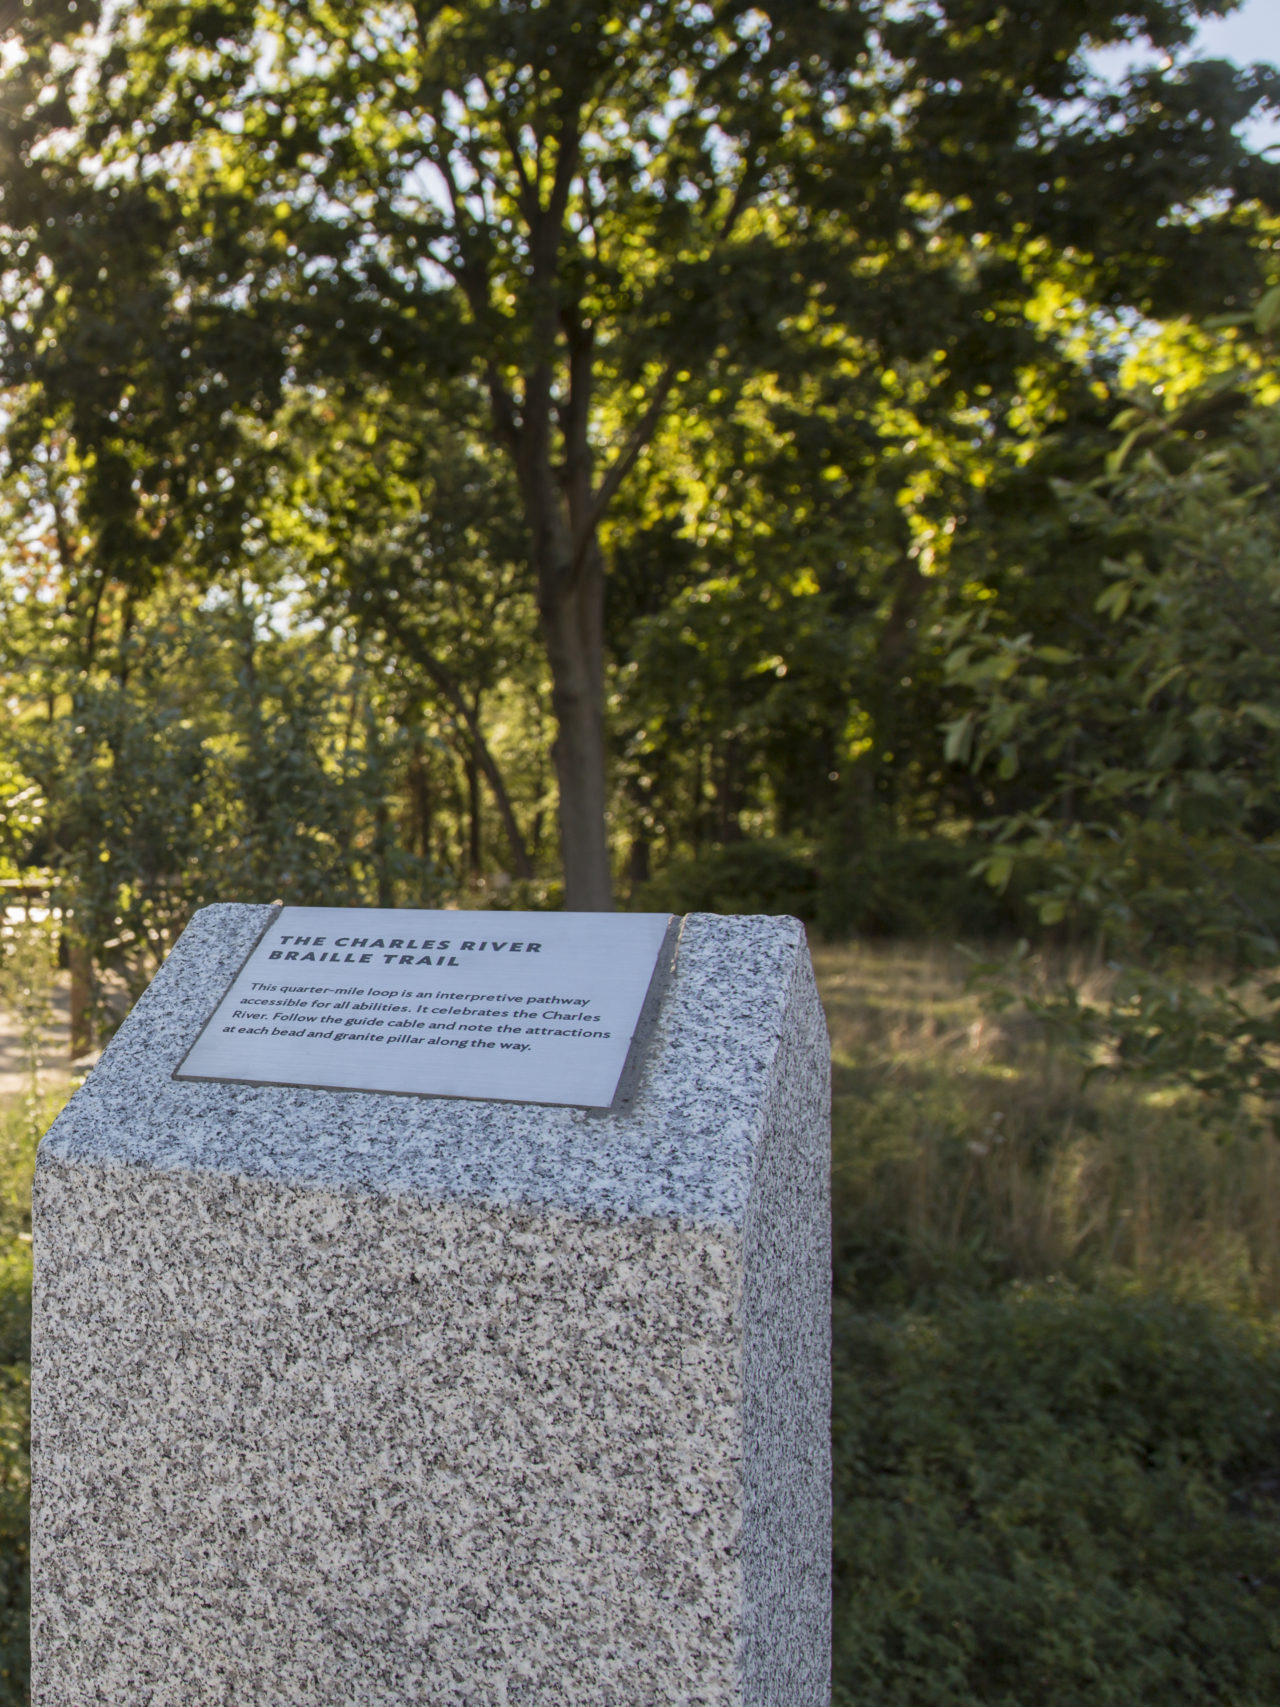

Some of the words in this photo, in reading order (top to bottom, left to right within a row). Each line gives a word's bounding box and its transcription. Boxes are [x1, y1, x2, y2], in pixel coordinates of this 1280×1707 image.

[280, 935, 327, 946] THE
[334, 937, 451, 951] CHARLES
[459, 941, 542, 953] RIVER
[268, 950, 373, 963] BRAILLE
[383, 954, 460, 967] TRAIL
[250, 982, 277, 992] This
[280, 985, 365, 996] quarter-mile
[367, 987, 399, 999] loop
[401, 989, 413, 998] is
[415, 991, 433, 999] an
[435, 991, 524, 1003] interpretive
[526, 995, 591, 1007] pathway
[240, 997, 308, 1008] accessible
[311, 999, 332, 1009] for
[333, 1001, 351, 1010] all
[352, 1002, 412, 1013] abilities.
[416, 1005, 431, 1013] It
[431, 1006, 509, 1018] celebrates
[512, 1010, 538, 1019] the
[542, 1010, 602, 1022] Charles
[231, 1010, 268, 1020] River.
[272, 1012, 318, 1023] Follow
[320, 1015, 343, 1024] the
[344, 1016, 385, 1027] guide
[387, 1018, 426, 1029] cable
[428, 1021, 456, 1031] and
[458, 1023, 493, 1033] note
[496, 1024, 522, 1034] the
[524, 1026, 611, 1039] attractions
[222, 1025, 236, 1033] at
[237, 1026, 269, 1036] each
[271, 1027, 306, 1038] bead
[306, 1030, 334, 1039] and
[333, 1031, 384, 1042] granite
[386, 1034, 426, 1044] pillar
[427, 1036, 469, 1049] along
[470, 1039, 496, 1049] the
[500, 1041, 532, 1052] way.
